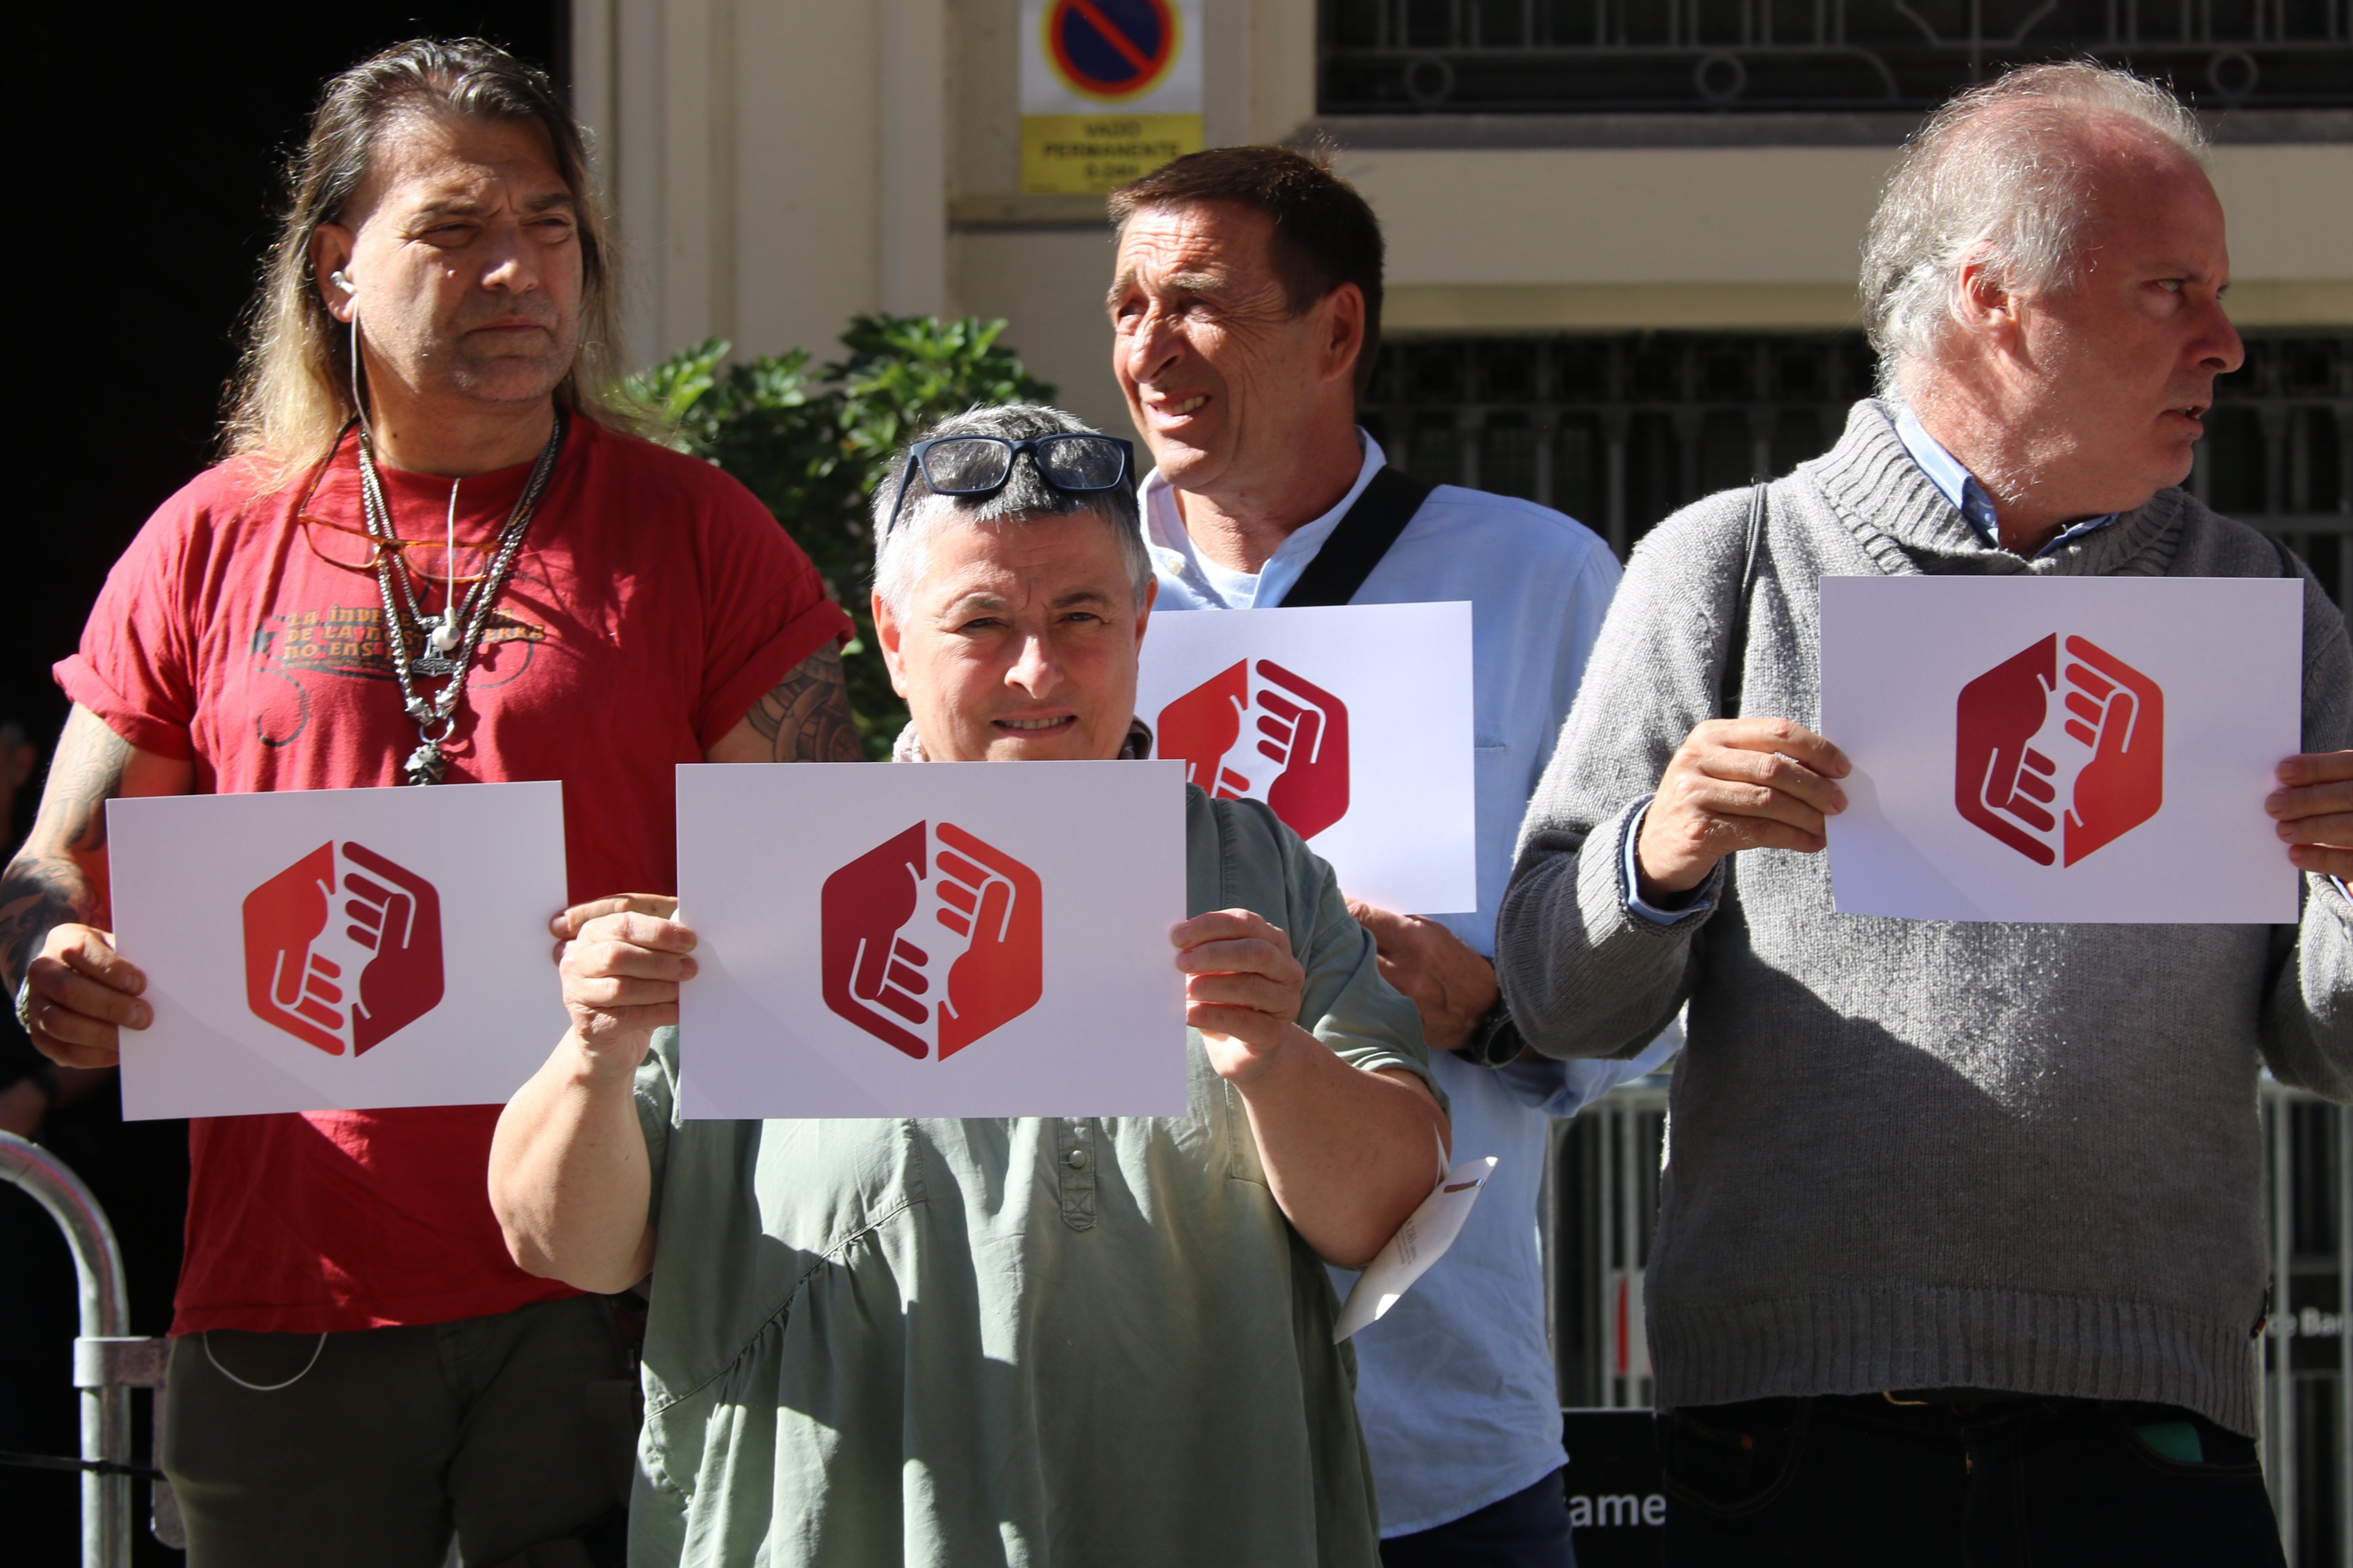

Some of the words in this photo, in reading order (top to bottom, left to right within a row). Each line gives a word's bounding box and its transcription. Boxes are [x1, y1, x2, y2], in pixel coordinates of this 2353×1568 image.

[1043, 142, 1180, 159] PERMANENTE
[289, 610, 318, 626] LA
[286, 627, 315, 643] DE
[322, 625, 353, 639] LA
[479, 624, 544, 642] ERRA
[283, 643, 318, 660] NO
[1564, 1493, 1667, 1527] ame
